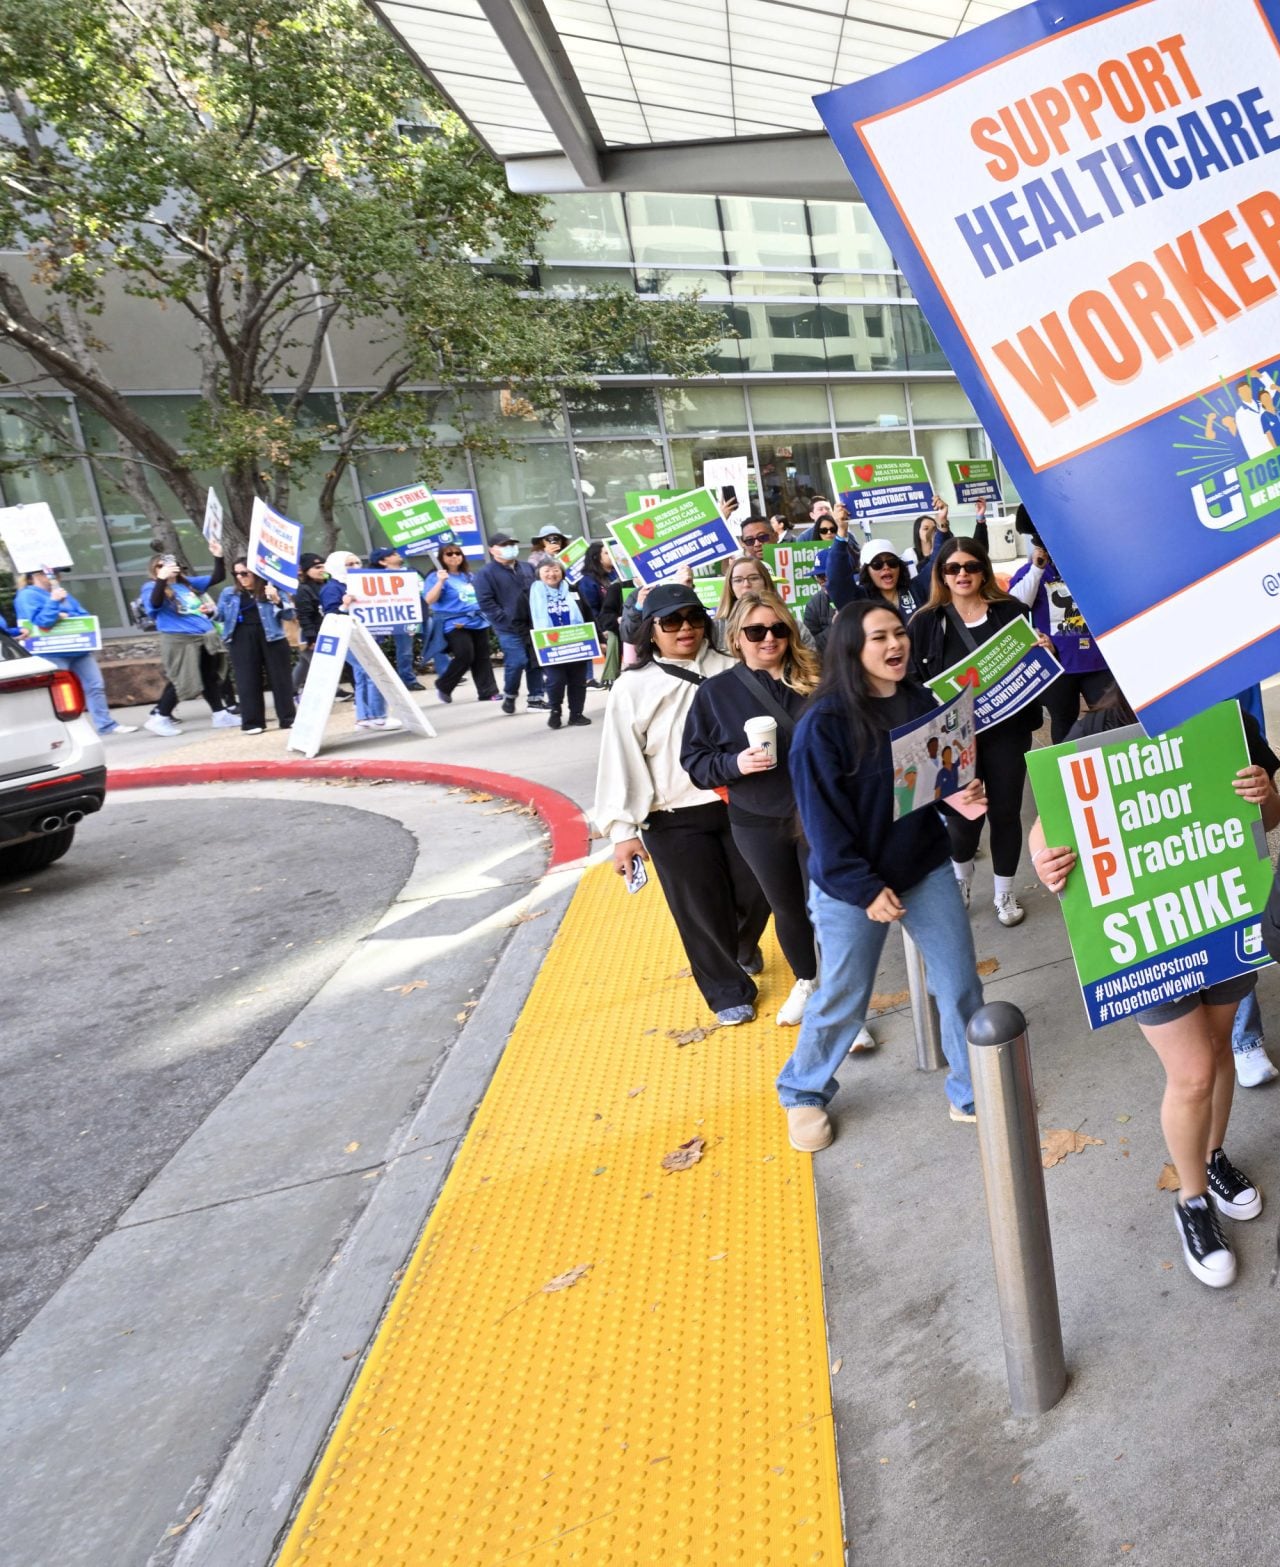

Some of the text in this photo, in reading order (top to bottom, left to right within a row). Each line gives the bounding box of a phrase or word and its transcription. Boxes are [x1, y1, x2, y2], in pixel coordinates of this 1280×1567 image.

[970, 34, 1202, 182] SUPPORT
[845, 464, 861, 488] I
[875, 469, 899, 477] HEALTH
[378, 489, 428, 512] ON STRIKE
[679, 501, 694, 511] AND
[854, 498, 872, 509] FAIR
[872, 492, 908, 505] CONTRACT
[908, 490, 925, 501] NOW
[1250, 492, 1269, 508] WE
[656, 507, 699, 530] HEALTH CARE
[625, 522, 648, 549] I
[646, 555, 666, 571] FAIR
[662, 540, 700, 564] CONTRACT
[698, 531, 719, 548] NOW
[362, 576, 404, 596] ULP
[353, 605, 417, 624] STRIKE
[977, 634, 1012, 667] NURSES AND
[980, 640, 1018, 676] HEALTH CARE
[982, 642, 1026, 683] PROFESSIONALS
[974, 702, 994, 718] FAIR
[991, 675, 1027, 707] CONTRACT
[1023, 659, 1042, 680] NOW
[1103, 866, 1253, 964] STRIKE
[1095, 949, 1209, 1002] #UNACUHCPstrong
[1099, 971, 1205, 1022] #TogetherWeWin
